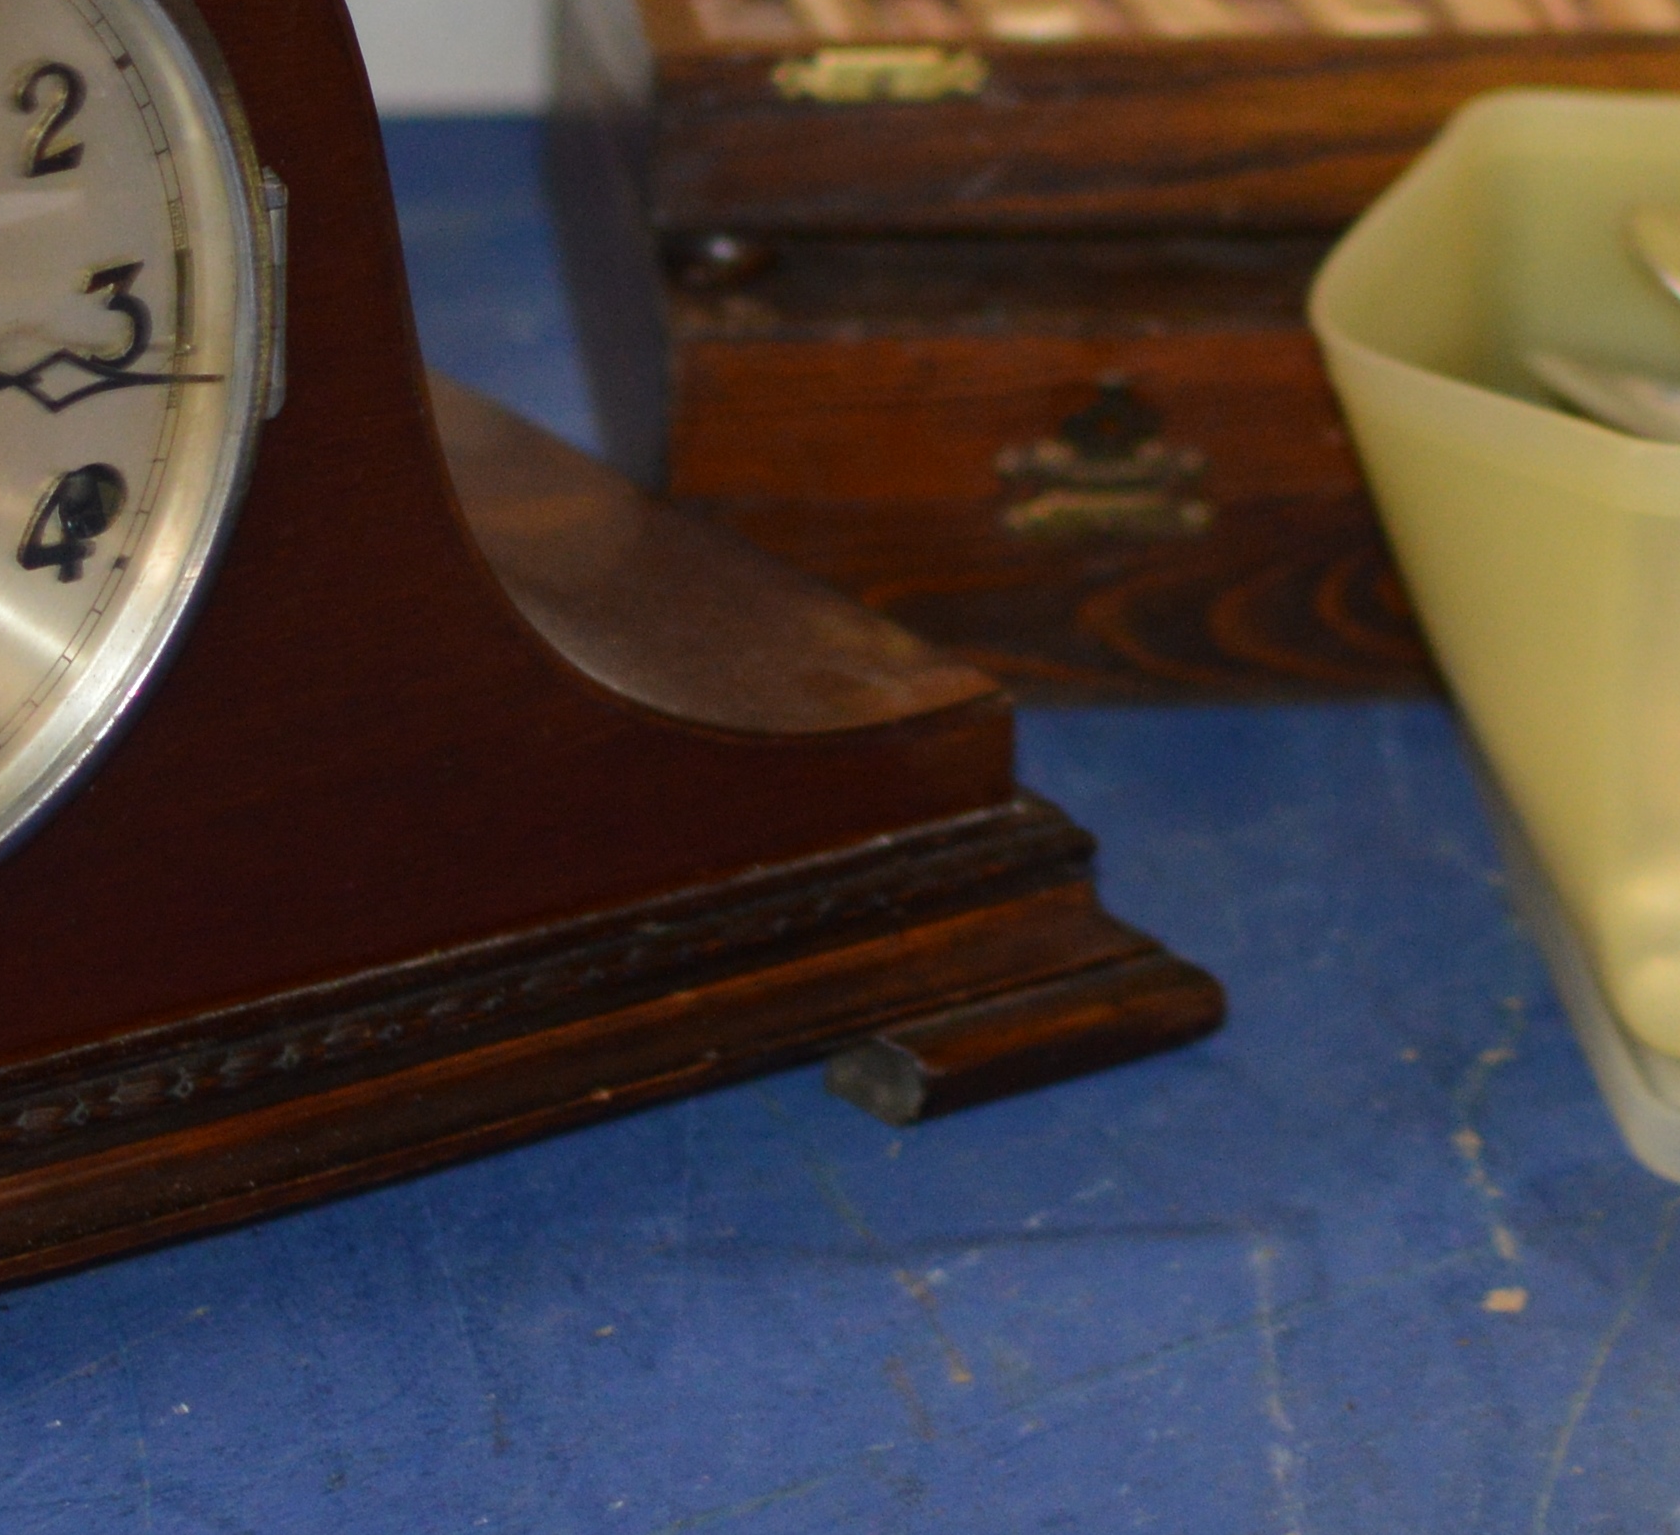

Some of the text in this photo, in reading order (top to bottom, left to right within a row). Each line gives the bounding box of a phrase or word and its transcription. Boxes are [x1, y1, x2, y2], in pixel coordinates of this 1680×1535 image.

[9, 59, 88, 179] 2
[79, 259, 155, 370] 3
[15, 463, 100, 585] 4
